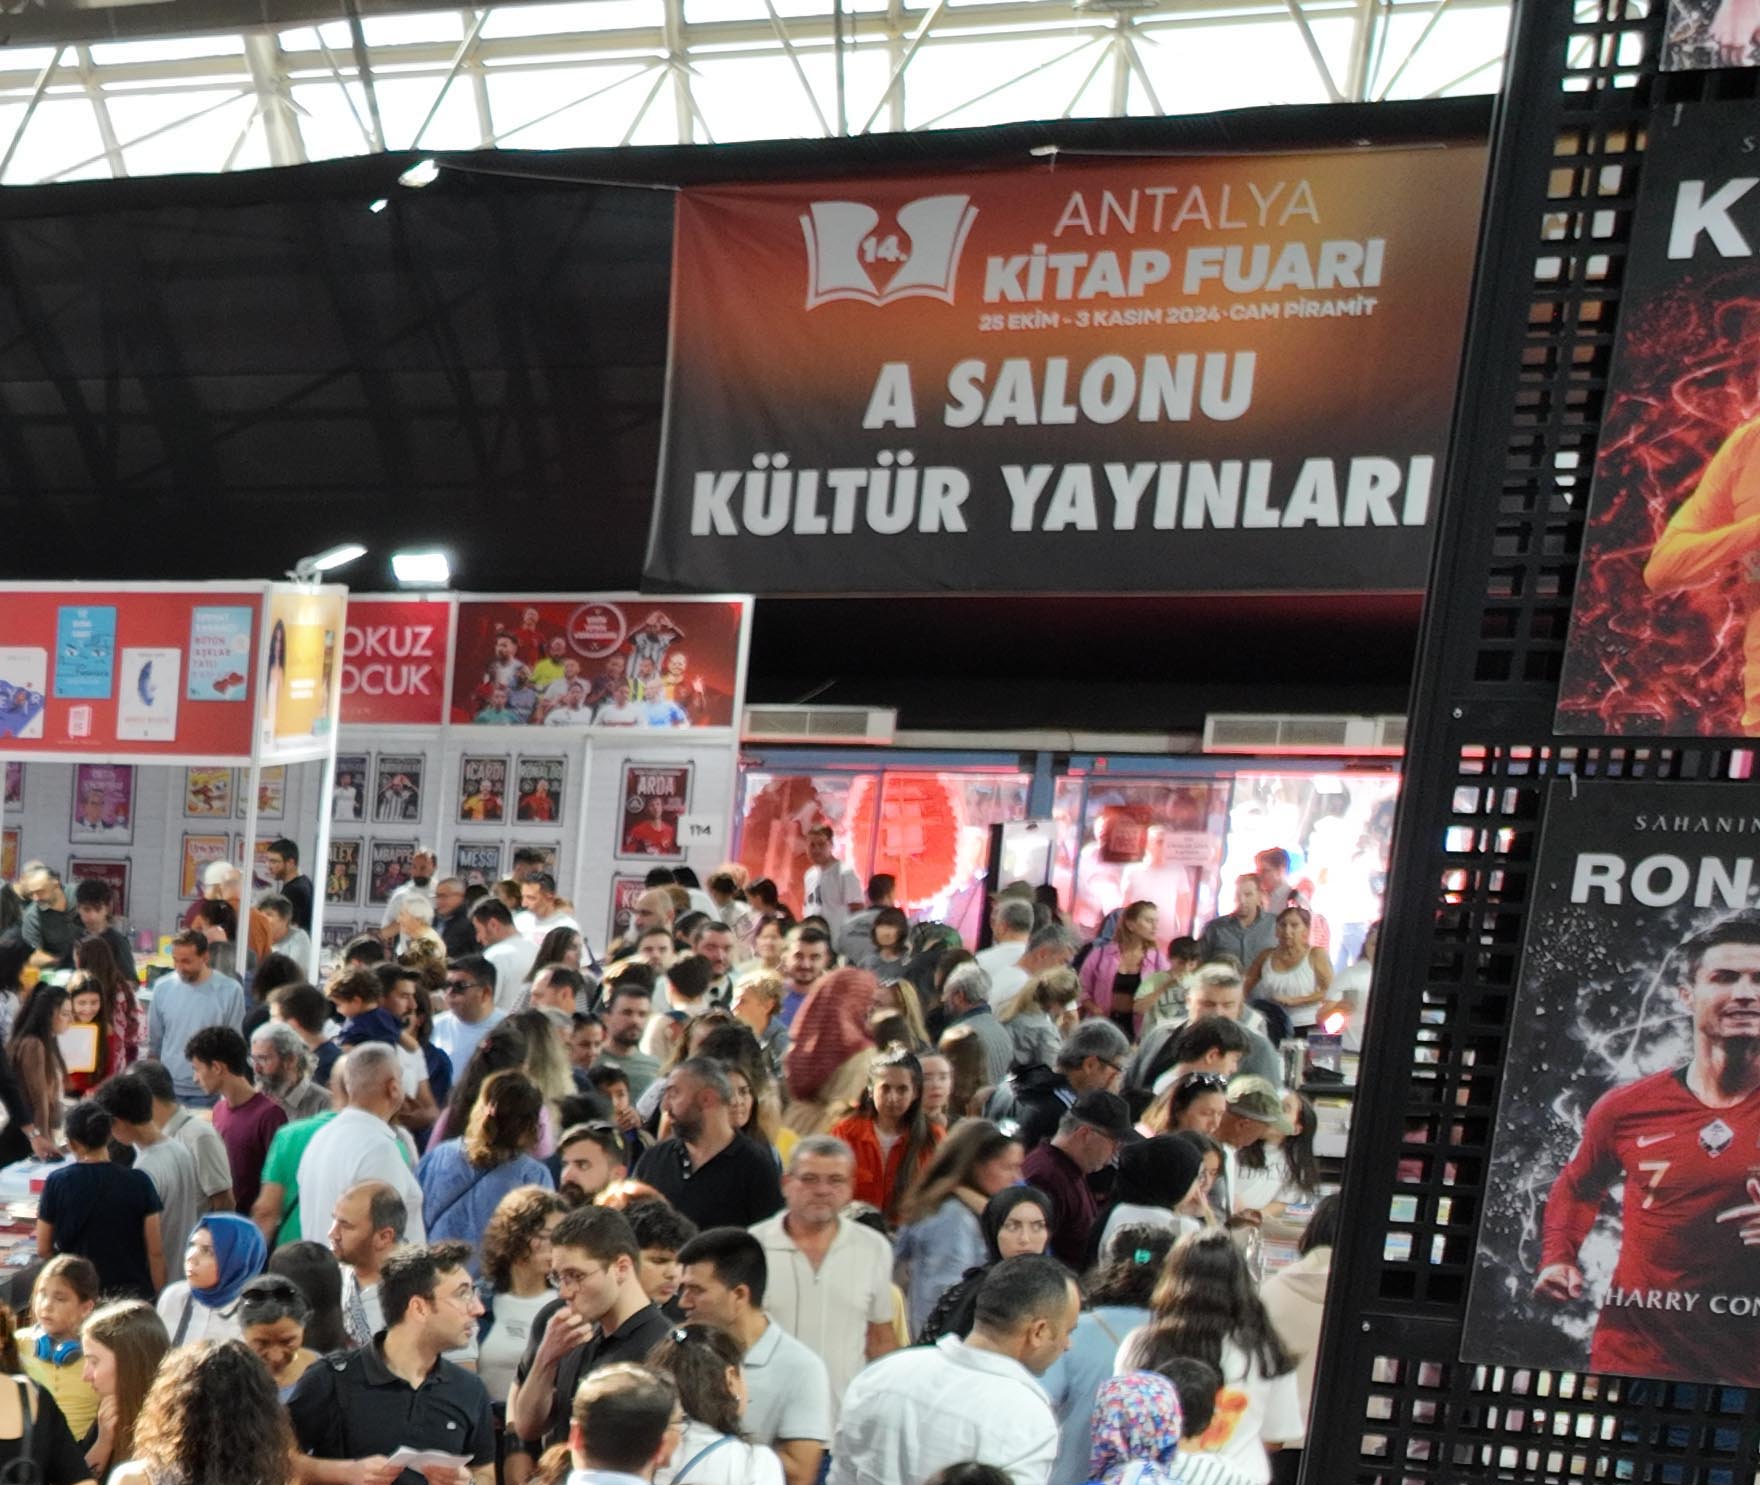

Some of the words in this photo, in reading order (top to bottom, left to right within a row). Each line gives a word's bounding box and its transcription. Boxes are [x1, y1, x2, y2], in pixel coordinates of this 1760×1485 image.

[1053, 180, 1321, 239] ANTALYA
[862, 234, 908, 264] 14.
[983, 245, 1170, 304] KİTAP
[1183, 237, 1387, 296] FUARI
[1007, 308, 1059, 330] EKİM
[1076, 311, 1090, 328] 3
[1093, 307, 1163, 328] KASIM
[1284, 295, 1379, 319] PİRAMİT
[863, 362, 917, 430] A
[944, 351, 1257, 428] SALONU
[690, 448, 972, 537] KÜLTÜR
[1001, 455, 1437, 534] YAYINLARI
[637, 776, 676, 796] ARDA
[1637, 1160, 1667, 1209] 7
[1603, 1285, 1701, 1313] HARRY
